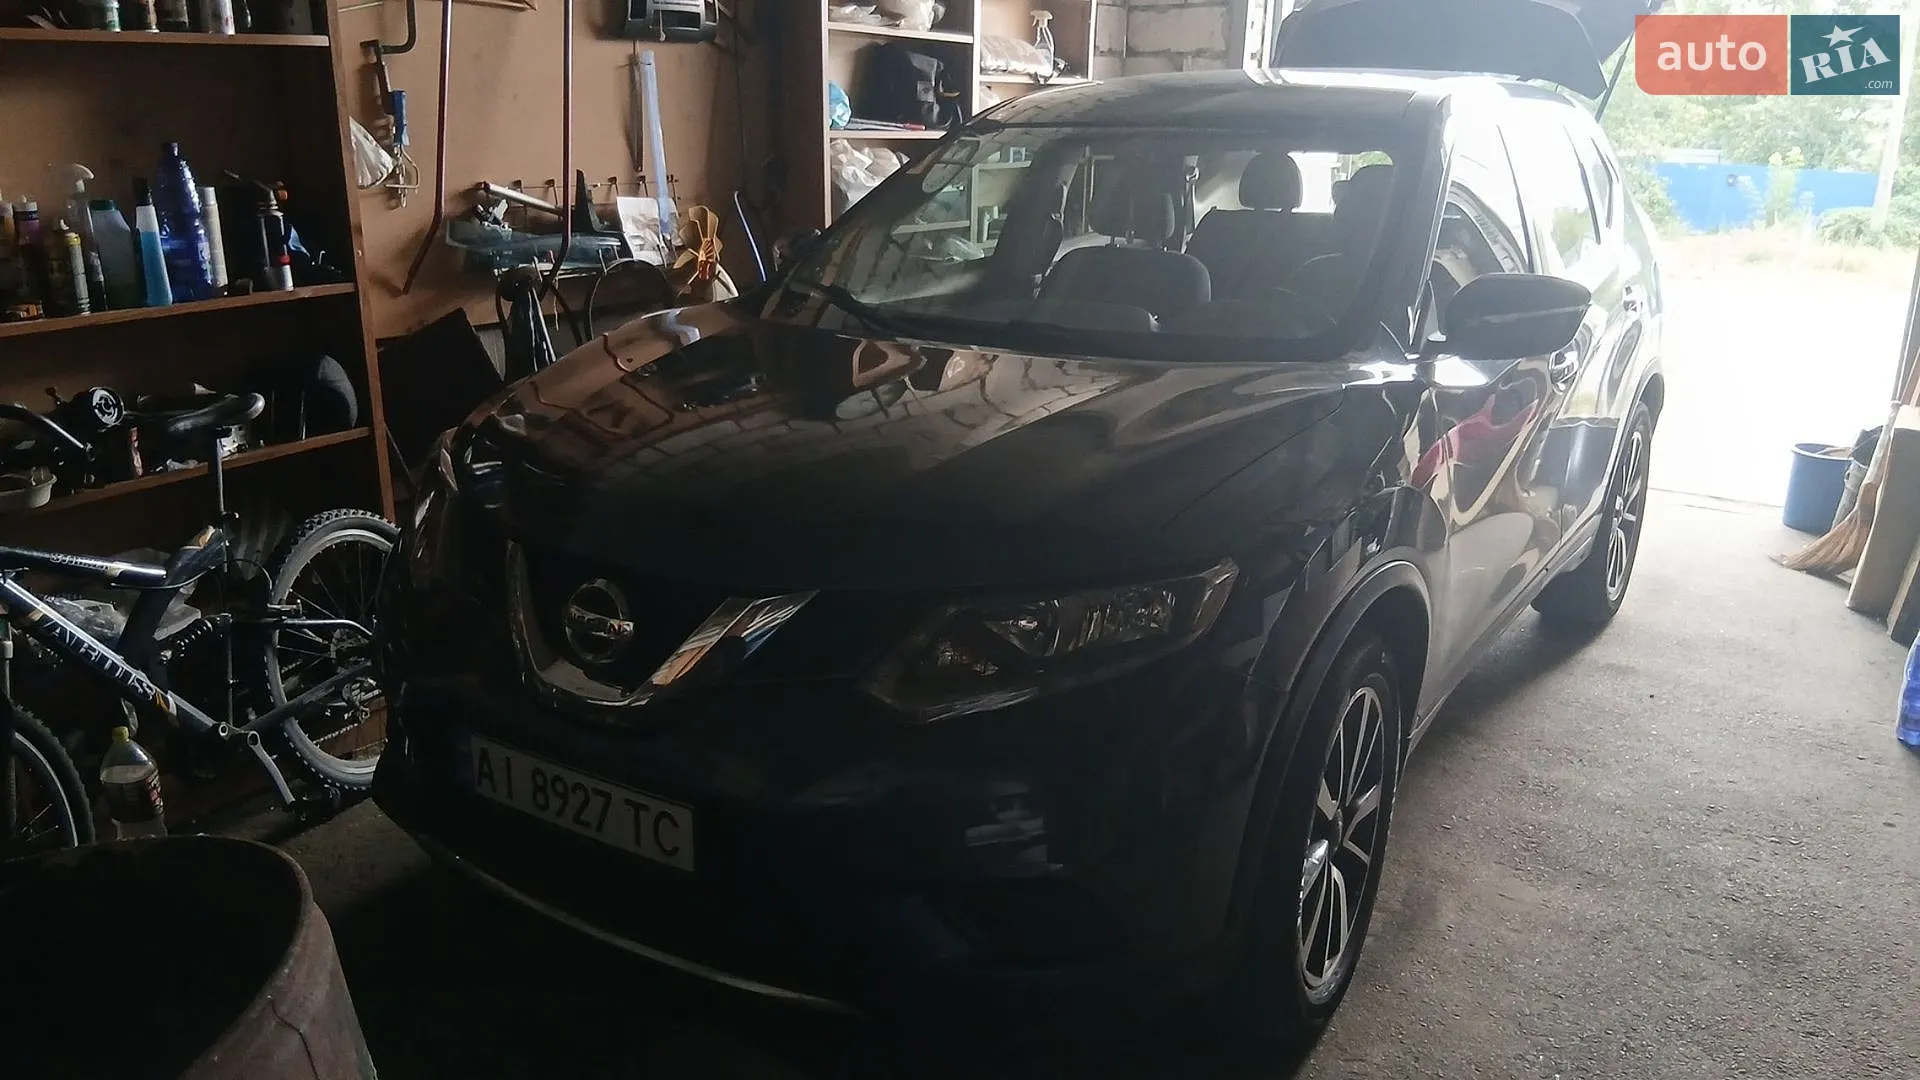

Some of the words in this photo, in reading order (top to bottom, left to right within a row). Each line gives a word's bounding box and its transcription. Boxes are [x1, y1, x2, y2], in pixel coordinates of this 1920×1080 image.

[477, 746, 514, 800] AI
[530, 766, 614, 835] 8927
[624, 798, 680, 858] TC
